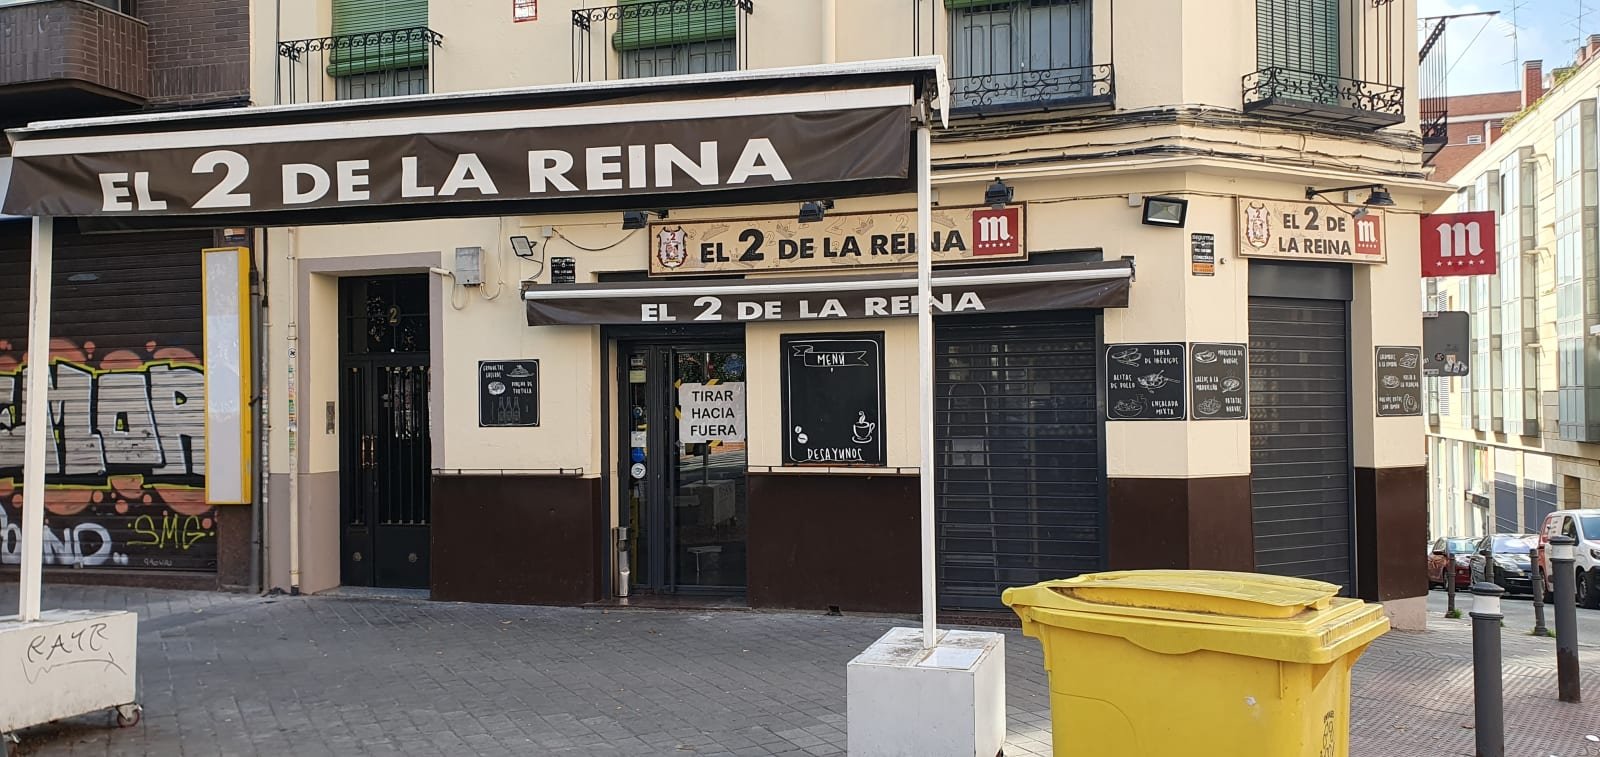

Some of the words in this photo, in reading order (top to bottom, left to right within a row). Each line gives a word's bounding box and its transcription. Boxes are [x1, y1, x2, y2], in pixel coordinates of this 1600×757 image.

[98, 171, 167, 212] EL
[191, 149, 251, 209] 2
[281, 159, 370, 205] DE
[401, 152, 499, 198] LA
[527, 137, 793, 193] REINA
[1283, 213, 1300, 230] EL
[1304, 206, 1319, 230] 2
[1326, 216, 1346, 232] DE
[701, 243, 730, 263] EL
[739, 228, 764, 261] 2
[778, 238, 814, 260] DE
[823, 236, 861, 257] LA
[1279, 237, 1299, 252] LA
[1303, 239, 1352, 255] REINA
[389, 307, 398, 323] 2
[641, 303, 677, 322] EL
[693, 296, 722, 320] 2
[737, 301, 782, 320] DE
[800, 299, 848, 318] LA
[1153, 348, 1171, 356] TABLA
[691, 390, 734, 402] TIRAR
[691, 407, 736, 420] HACIA
[1155, 408, 1174, 416] MIXTA
[690, 424, 738, 437] FUERA
[807, 447, 865, 462] DESAYUNOS
